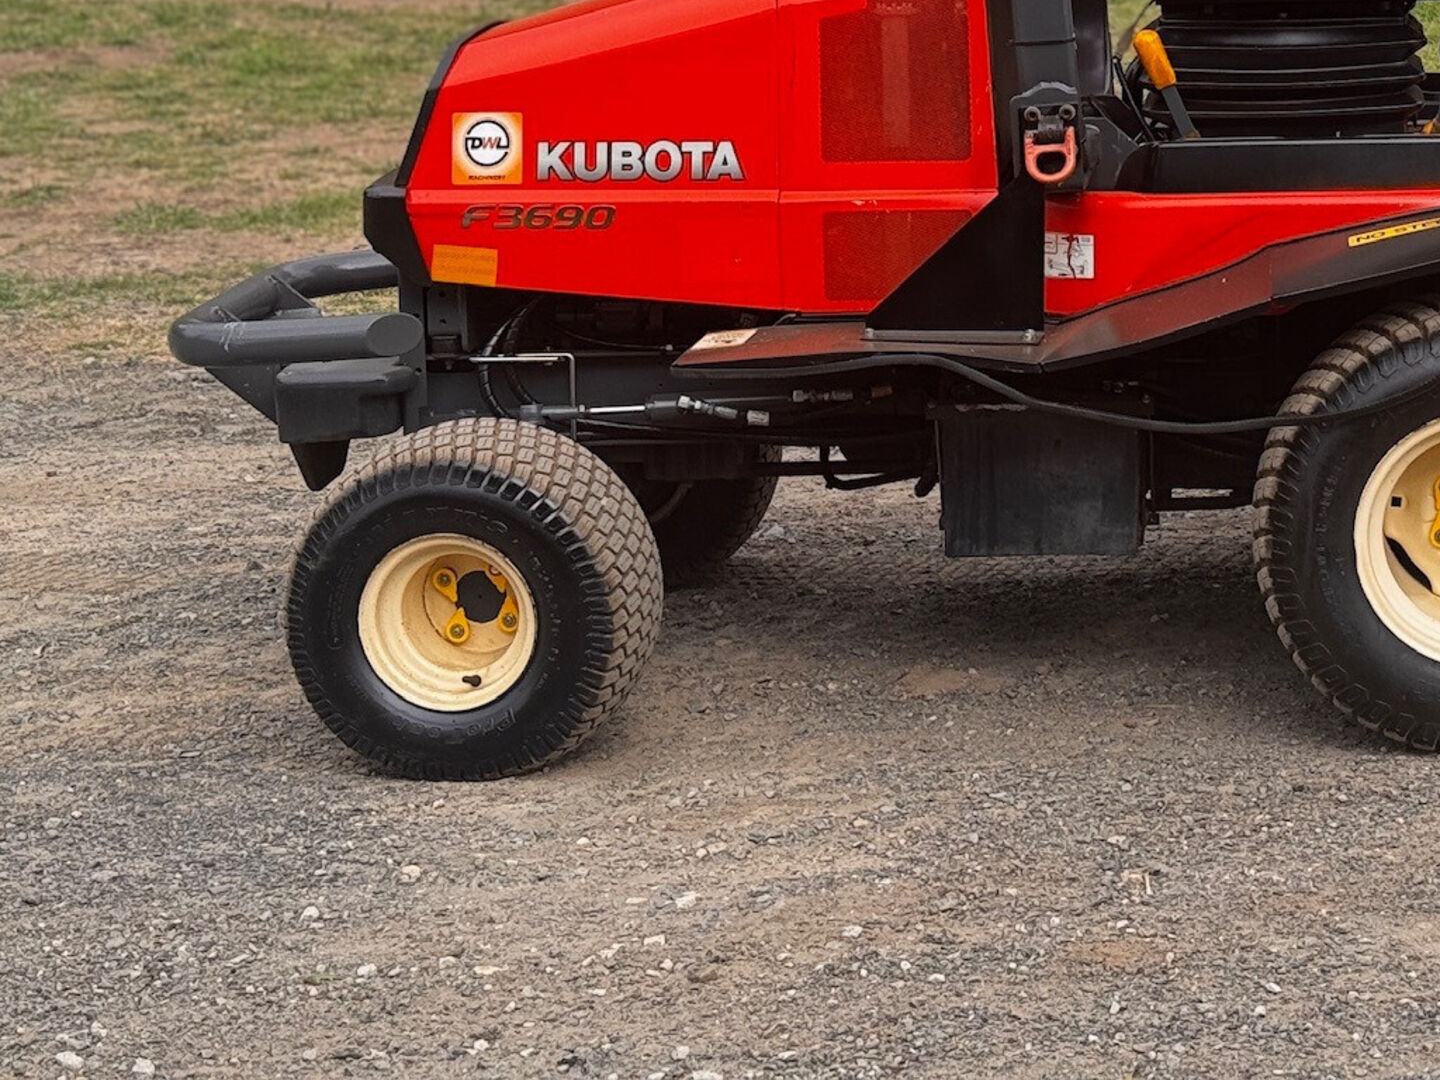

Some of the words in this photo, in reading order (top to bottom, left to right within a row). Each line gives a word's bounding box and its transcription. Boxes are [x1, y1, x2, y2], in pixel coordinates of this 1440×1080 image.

[467, 136, 510, 150] DWL
[536, 140, 746, 181] KUBOTA
[461, 204, 617, 231] F3690
[1356, 231, 1386, 242] NO
